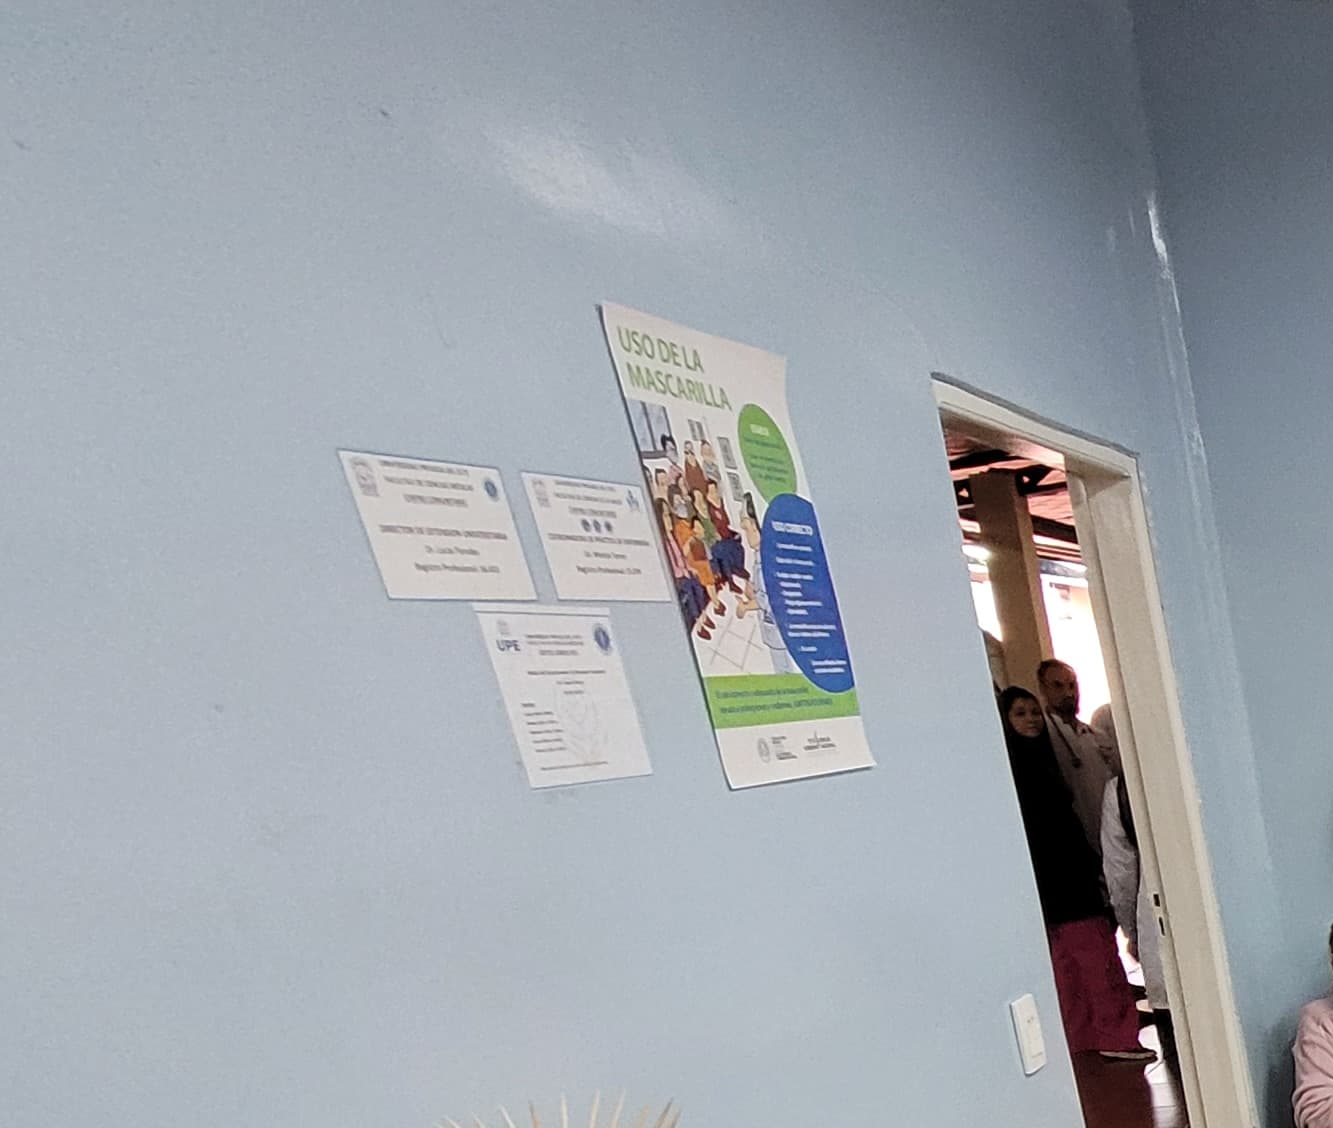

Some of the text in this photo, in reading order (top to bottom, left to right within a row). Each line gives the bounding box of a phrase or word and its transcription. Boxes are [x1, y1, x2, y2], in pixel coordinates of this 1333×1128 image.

[617, 325, 704, 373] USO DE LA
[626, 361, 732, 411] MASCARILLA
[496, 640, 521, 652] UPE
